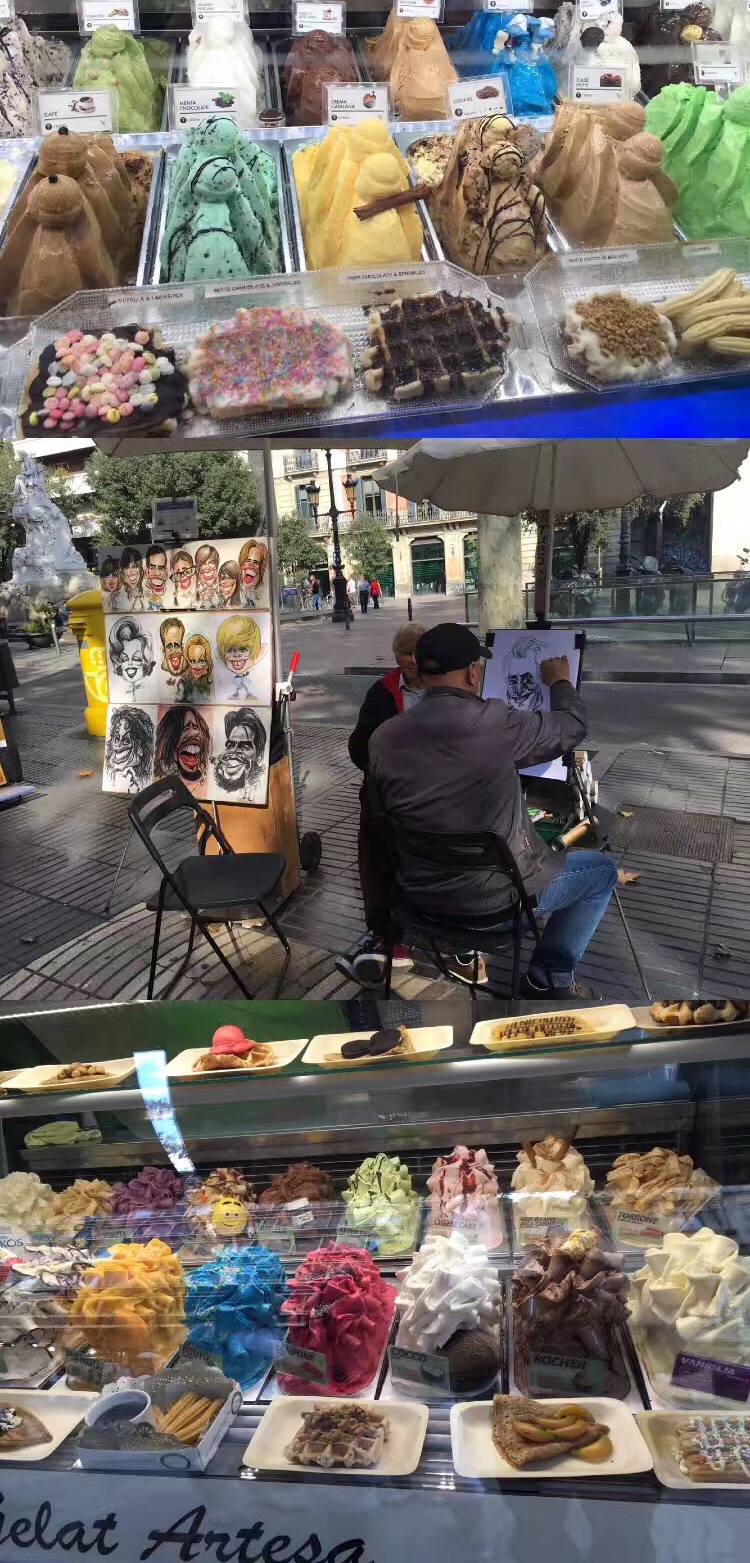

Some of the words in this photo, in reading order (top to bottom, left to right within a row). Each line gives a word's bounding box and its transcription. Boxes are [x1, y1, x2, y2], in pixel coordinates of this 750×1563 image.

[617, 1211, 659, 1225] TORRONE
[391, 1348, 427, 1363] COCCO
[533, 1355, 587, 1370] ROCHER
[681, 1357, 735, 1376] VANIGLIA
